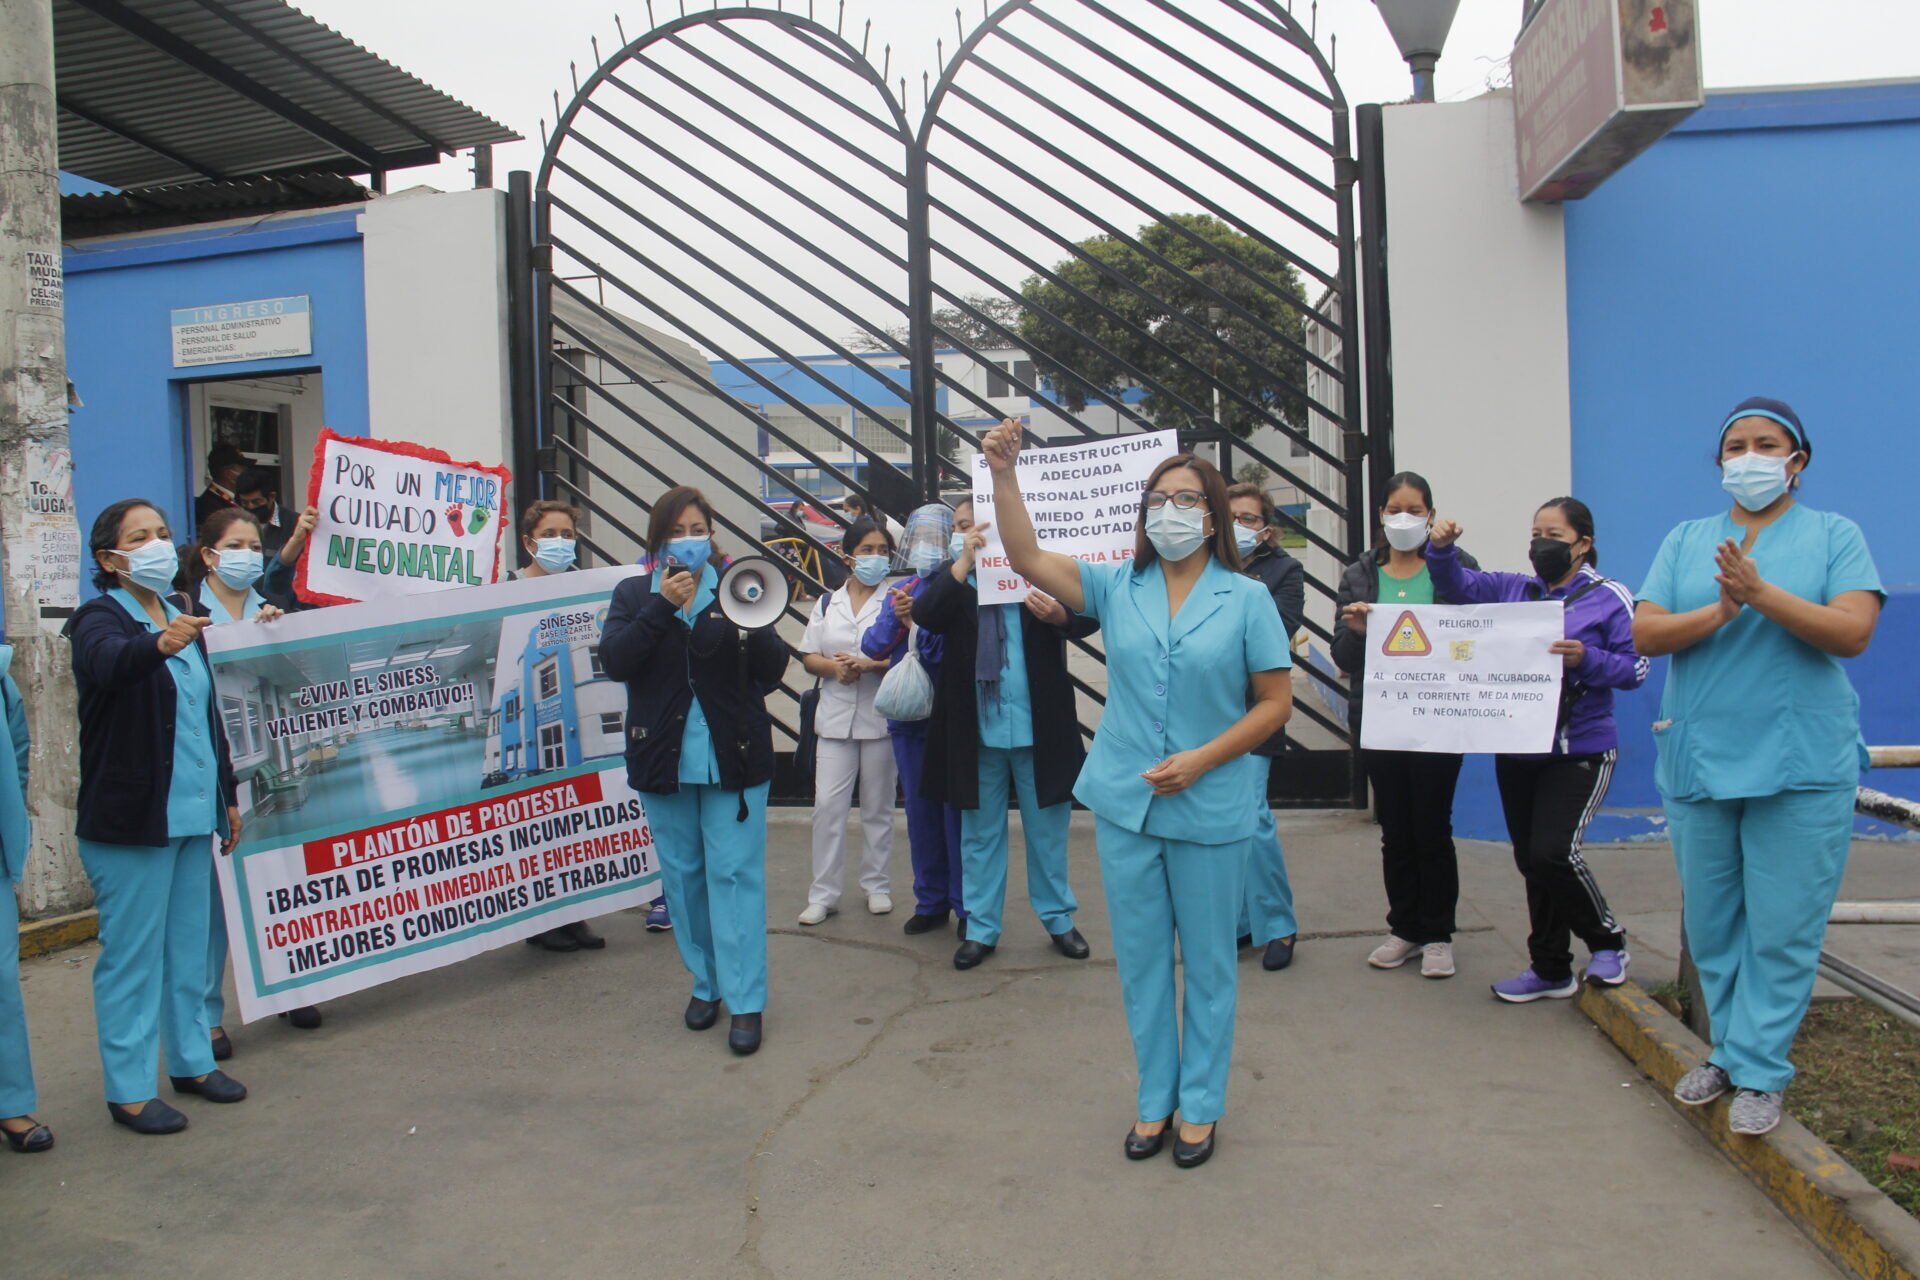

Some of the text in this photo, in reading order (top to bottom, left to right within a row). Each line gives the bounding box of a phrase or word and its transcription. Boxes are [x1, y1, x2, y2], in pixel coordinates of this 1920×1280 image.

[1513, 0, 1610, 119] EMERGENC
[27, 252, 53, 266] TAXI
[194, 301, 285, 322] INGRESO
[180, 316, 281, 335] PERSONAL ADMINISTRATIVO
[181, 330, 257, 346] PERSONAL DE SALUD
[336, 454, 498, 510] POR UN MEJOR
[1040, 463, 1123, 482] ADECUADA
[330, 495, 436, 535] CUIDADO
[1035, 511, 1084, 522] MIEDO
[1094, 508, 1105, 519] A
[327, 534, 483, 586] NEONATAL
[997, 579, 1018, 591] SU
[540, 611, 590, 630] SINESSS
[540, 624, 593, 640] BASE LAZARTE
[301, 665, 440, 706] ¿VIVA EL SINESS,
[1373, 672, 1551, 683] AL CONECTAR UNA INCUBADORA
[1380, 690, 1544, 701] A LA CORRIENTE ME DA MIEDO
[267, 683, 474, 739] VALIENTE Y COMBATIVO!!
[1412, 707, 1425, 716] EN
[332, 784, 579, 867] PLANTÓN DE PROTESTA
[266, 799, 646, 915] ¡BASTA DE PROMESAS INCUMPLIDAS!
[265, 887, 420, 950] ¡CONTRATACIÓN
[424, 862, 515, 907] INMEDIATA
[519, 854, 539, 880] DE
[287, 852, 648, 974] ¡MEJORES CONDICIONES DE TRABAJO!
